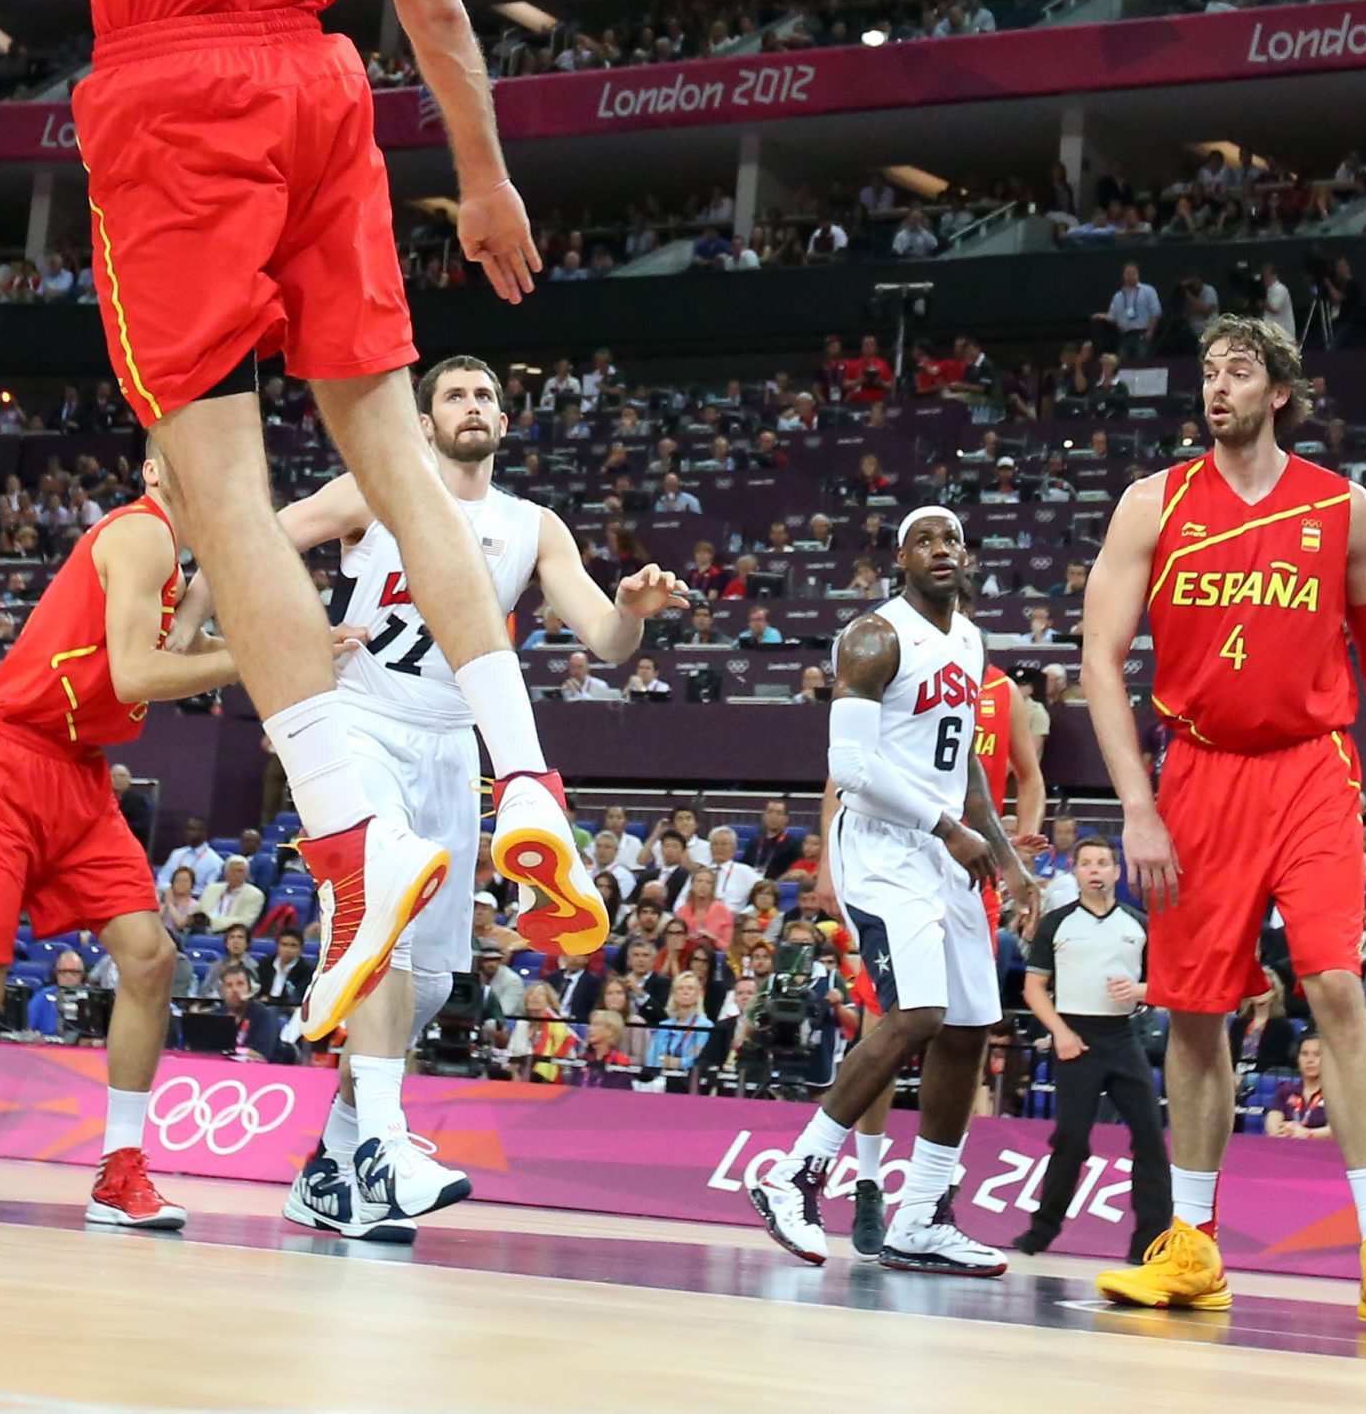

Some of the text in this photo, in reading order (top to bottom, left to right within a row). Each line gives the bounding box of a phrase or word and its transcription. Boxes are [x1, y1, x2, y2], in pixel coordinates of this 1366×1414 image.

[597, 64, 817, 119] London 2012
[1172, 561, 1320, 613] ESPAÑA
[1218, 623, 1248, 671] 4
[912, 661, 981, 716] USA
[933, 716, 963, 771] 6
